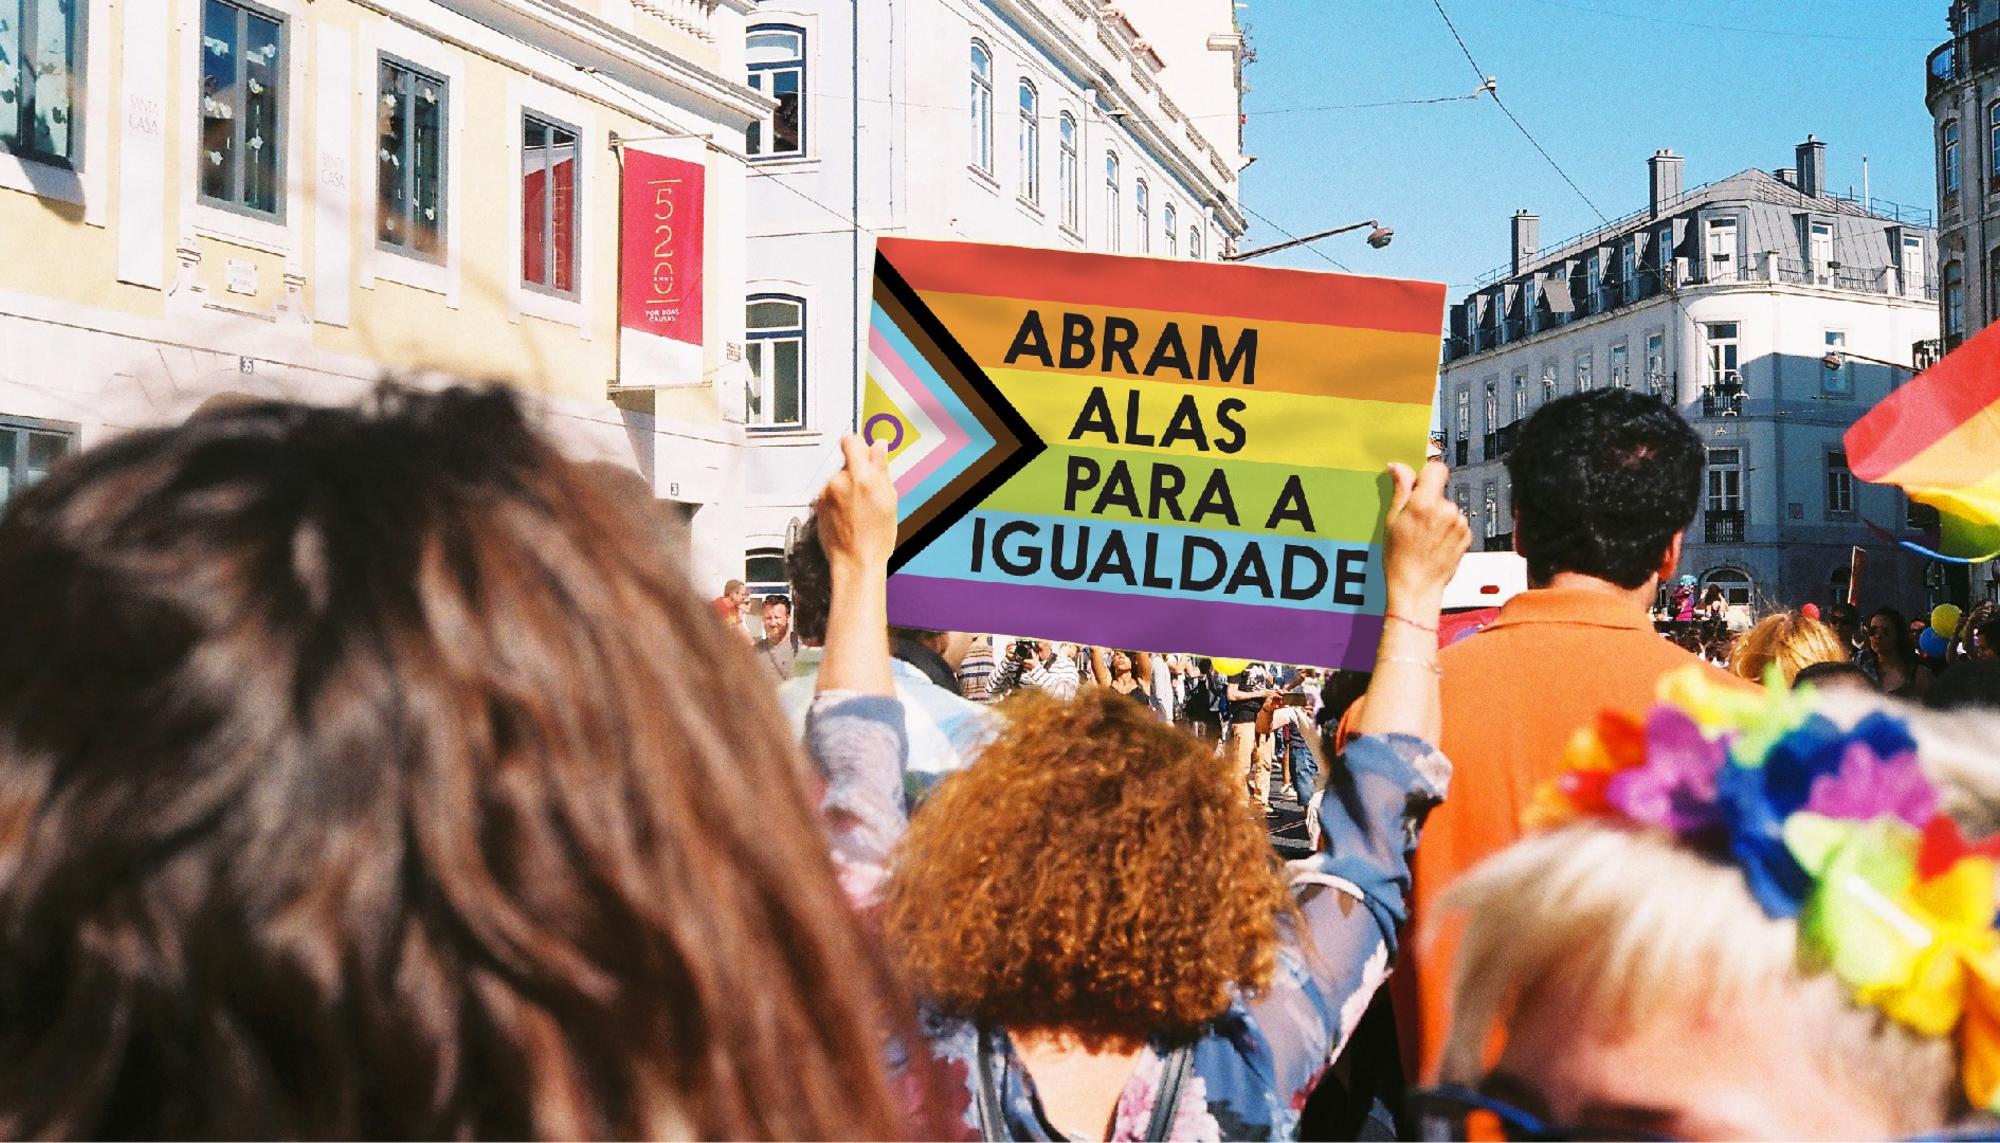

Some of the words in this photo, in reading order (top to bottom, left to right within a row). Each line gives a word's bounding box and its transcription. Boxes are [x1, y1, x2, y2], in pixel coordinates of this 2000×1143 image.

[128, 112, 159, 135] CASA
[646, 309, 660, 317] POR
[1004, 310, 1258, 385] ABRAM
[1068, 386, 1246, 454] ALAS
[1064, 455, 1240, 527] PARA
[1265, 475, 1315, 532] A
[971, 517, 1369, 606] IGUALDADE
